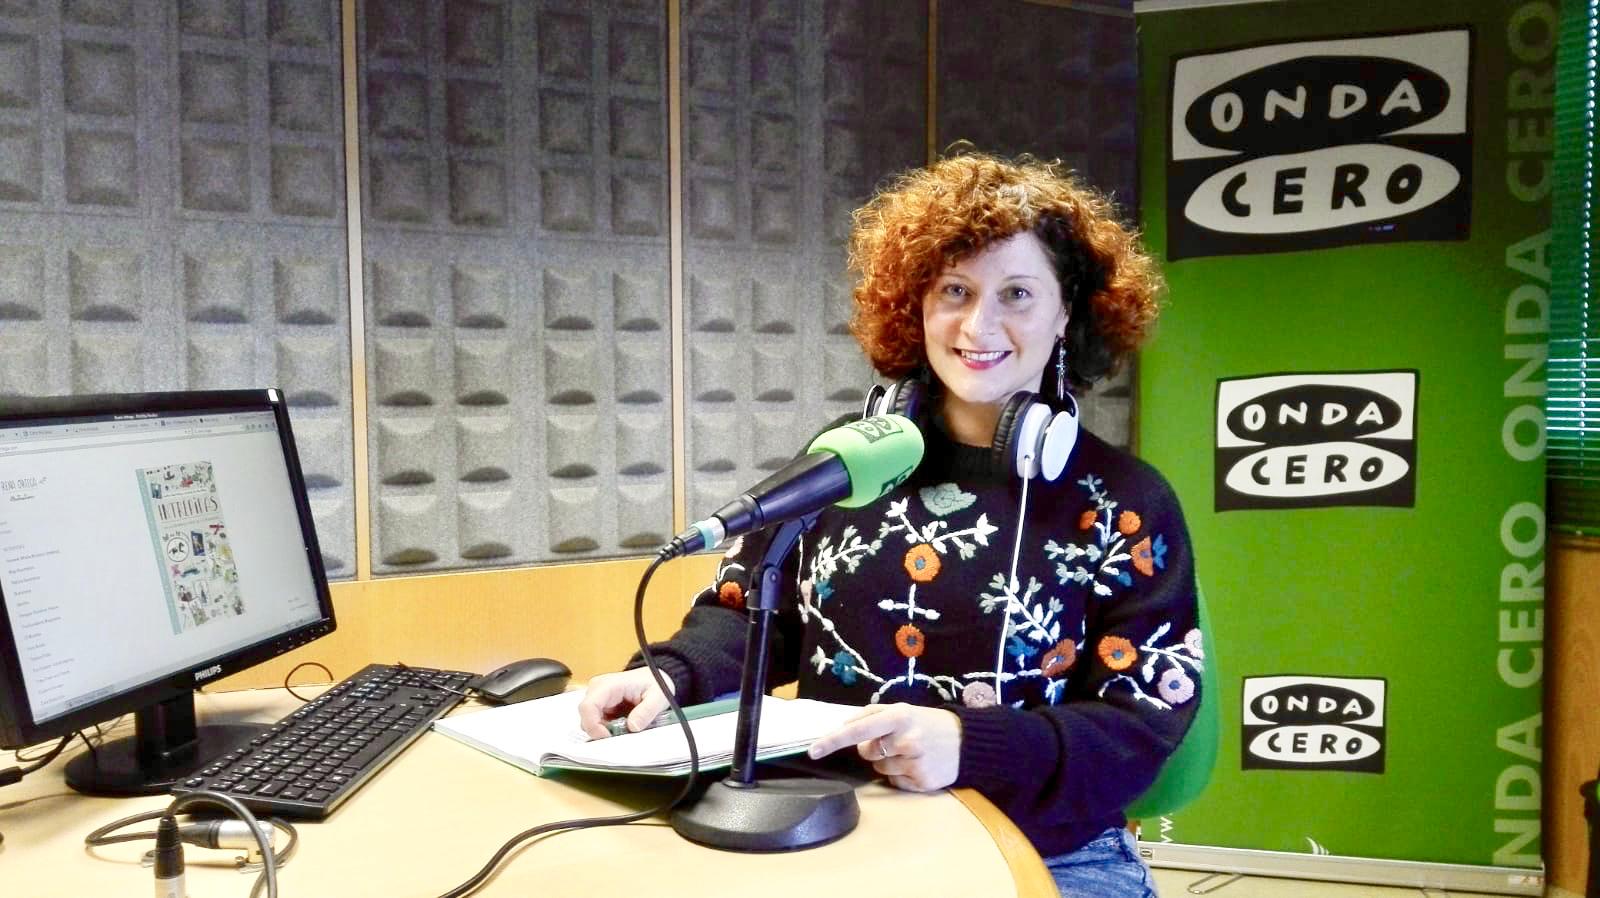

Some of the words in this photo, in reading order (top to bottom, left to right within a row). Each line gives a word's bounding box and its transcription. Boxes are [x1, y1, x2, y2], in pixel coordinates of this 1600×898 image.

[1210, 79, 1422, 133] ONDA
[1506, 3, 1558, 202] CERO
[1221, 163, 1423, 218] CERO
[1502, 228, 1553, 462] ONDA
[1242, 401, 1384, 431] ONDA
[1251, 454, 1384, 486] CERO
[1497, 502, 1546, 689] CERO
[194, 664, 222, 681] PHILIPS
[1261, 695, 1363, 715] ONDA
[1268, 732, 1363, 755] CERO
